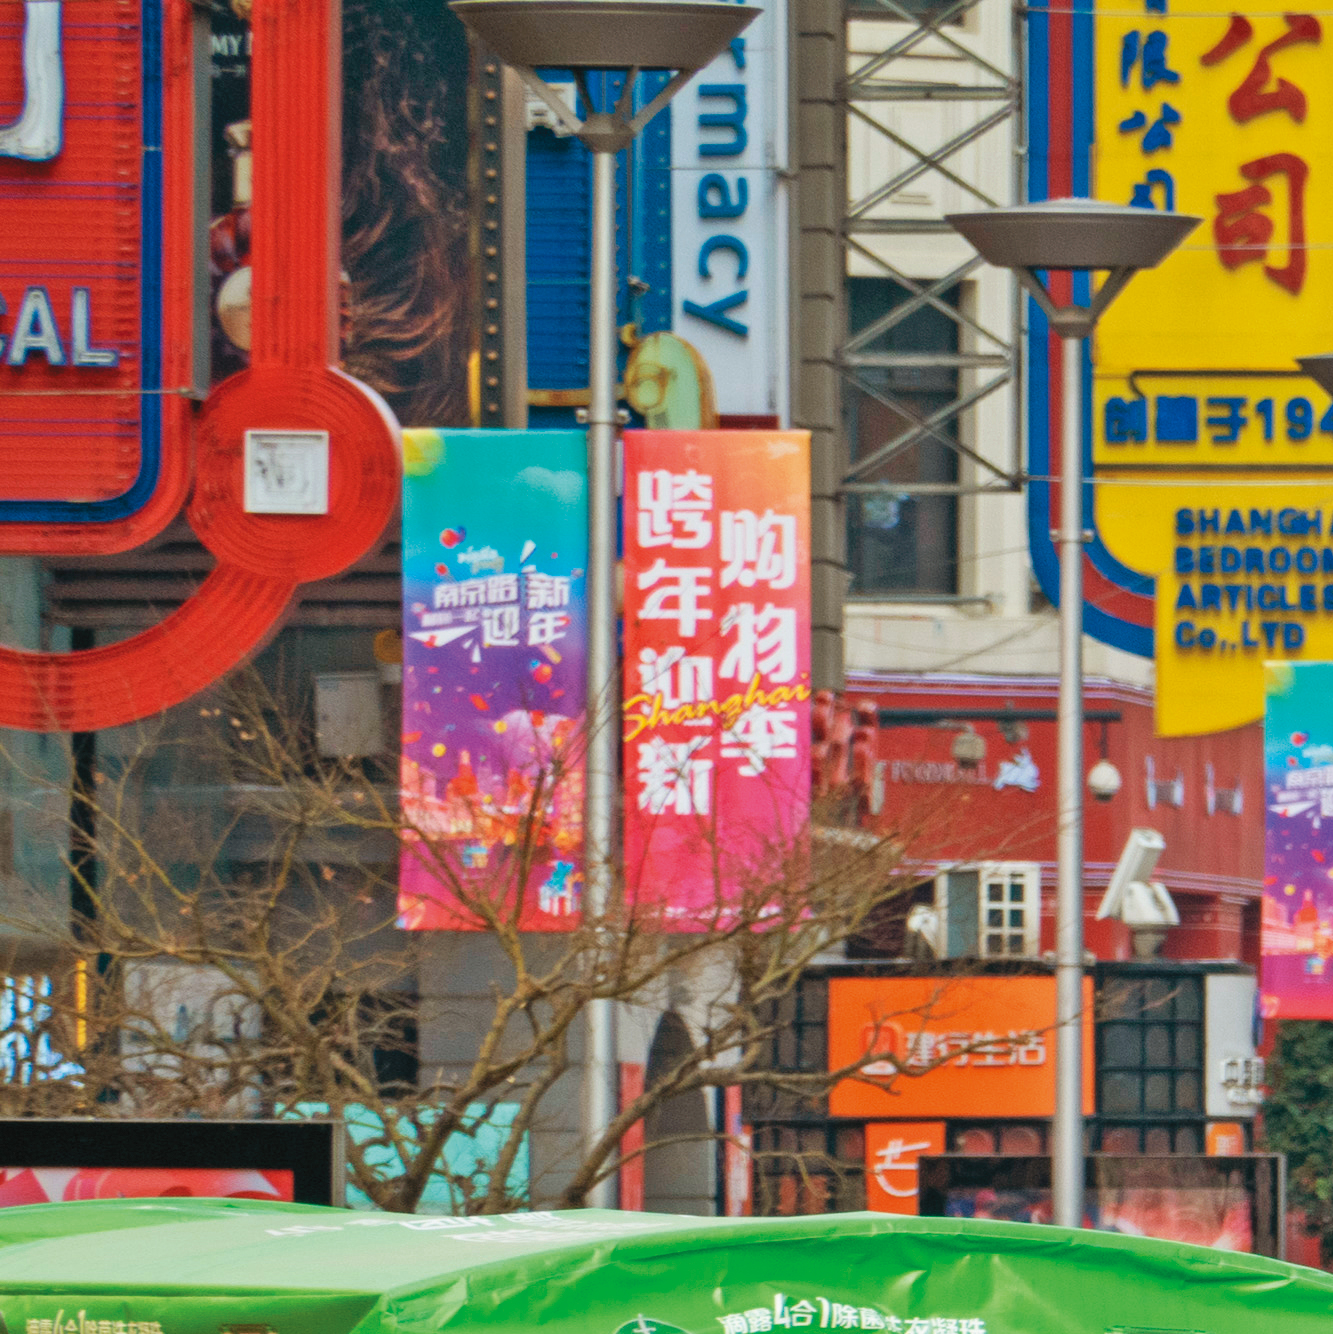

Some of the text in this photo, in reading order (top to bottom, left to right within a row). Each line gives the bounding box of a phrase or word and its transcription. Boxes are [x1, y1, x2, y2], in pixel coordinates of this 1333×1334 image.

[1120, 0, 1180, 213] 限公司
[1200, 14, 1323, 297] 公司
[0, 284, 121, 368] AL
[623, 672, 812, 743] Shanghai
[636, 470, 714, 816] 跨年迎新
[718, 510, 798, 777] 购物季
